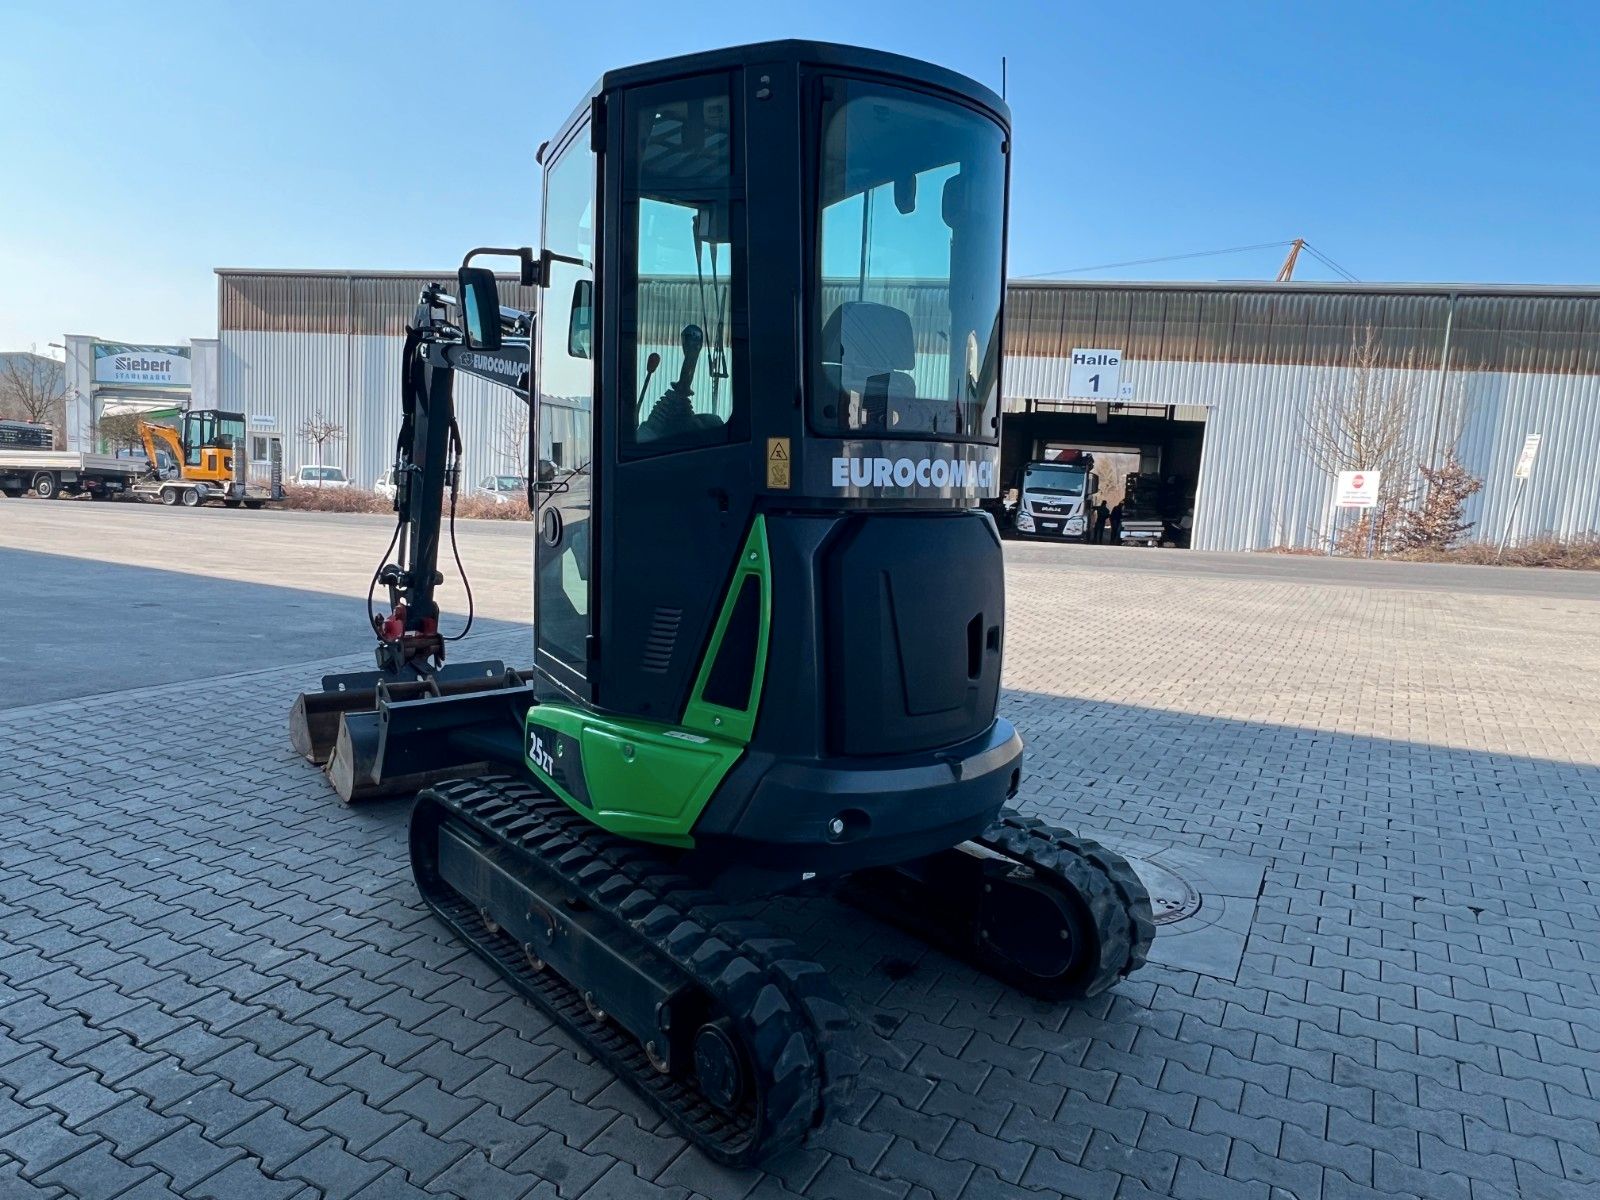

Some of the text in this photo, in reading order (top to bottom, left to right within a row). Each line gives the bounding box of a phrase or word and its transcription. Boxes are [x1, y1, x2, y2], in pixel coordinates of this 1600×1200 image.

[115, 356, 172, 372] Siebert
[473, 354, 530, 377] EUROCOMACH
[1073, 354, 1119, 366] Halle
[1088, 374, 1100, 393] 1
[831, 457, 993, 488] EUROCOMACH
